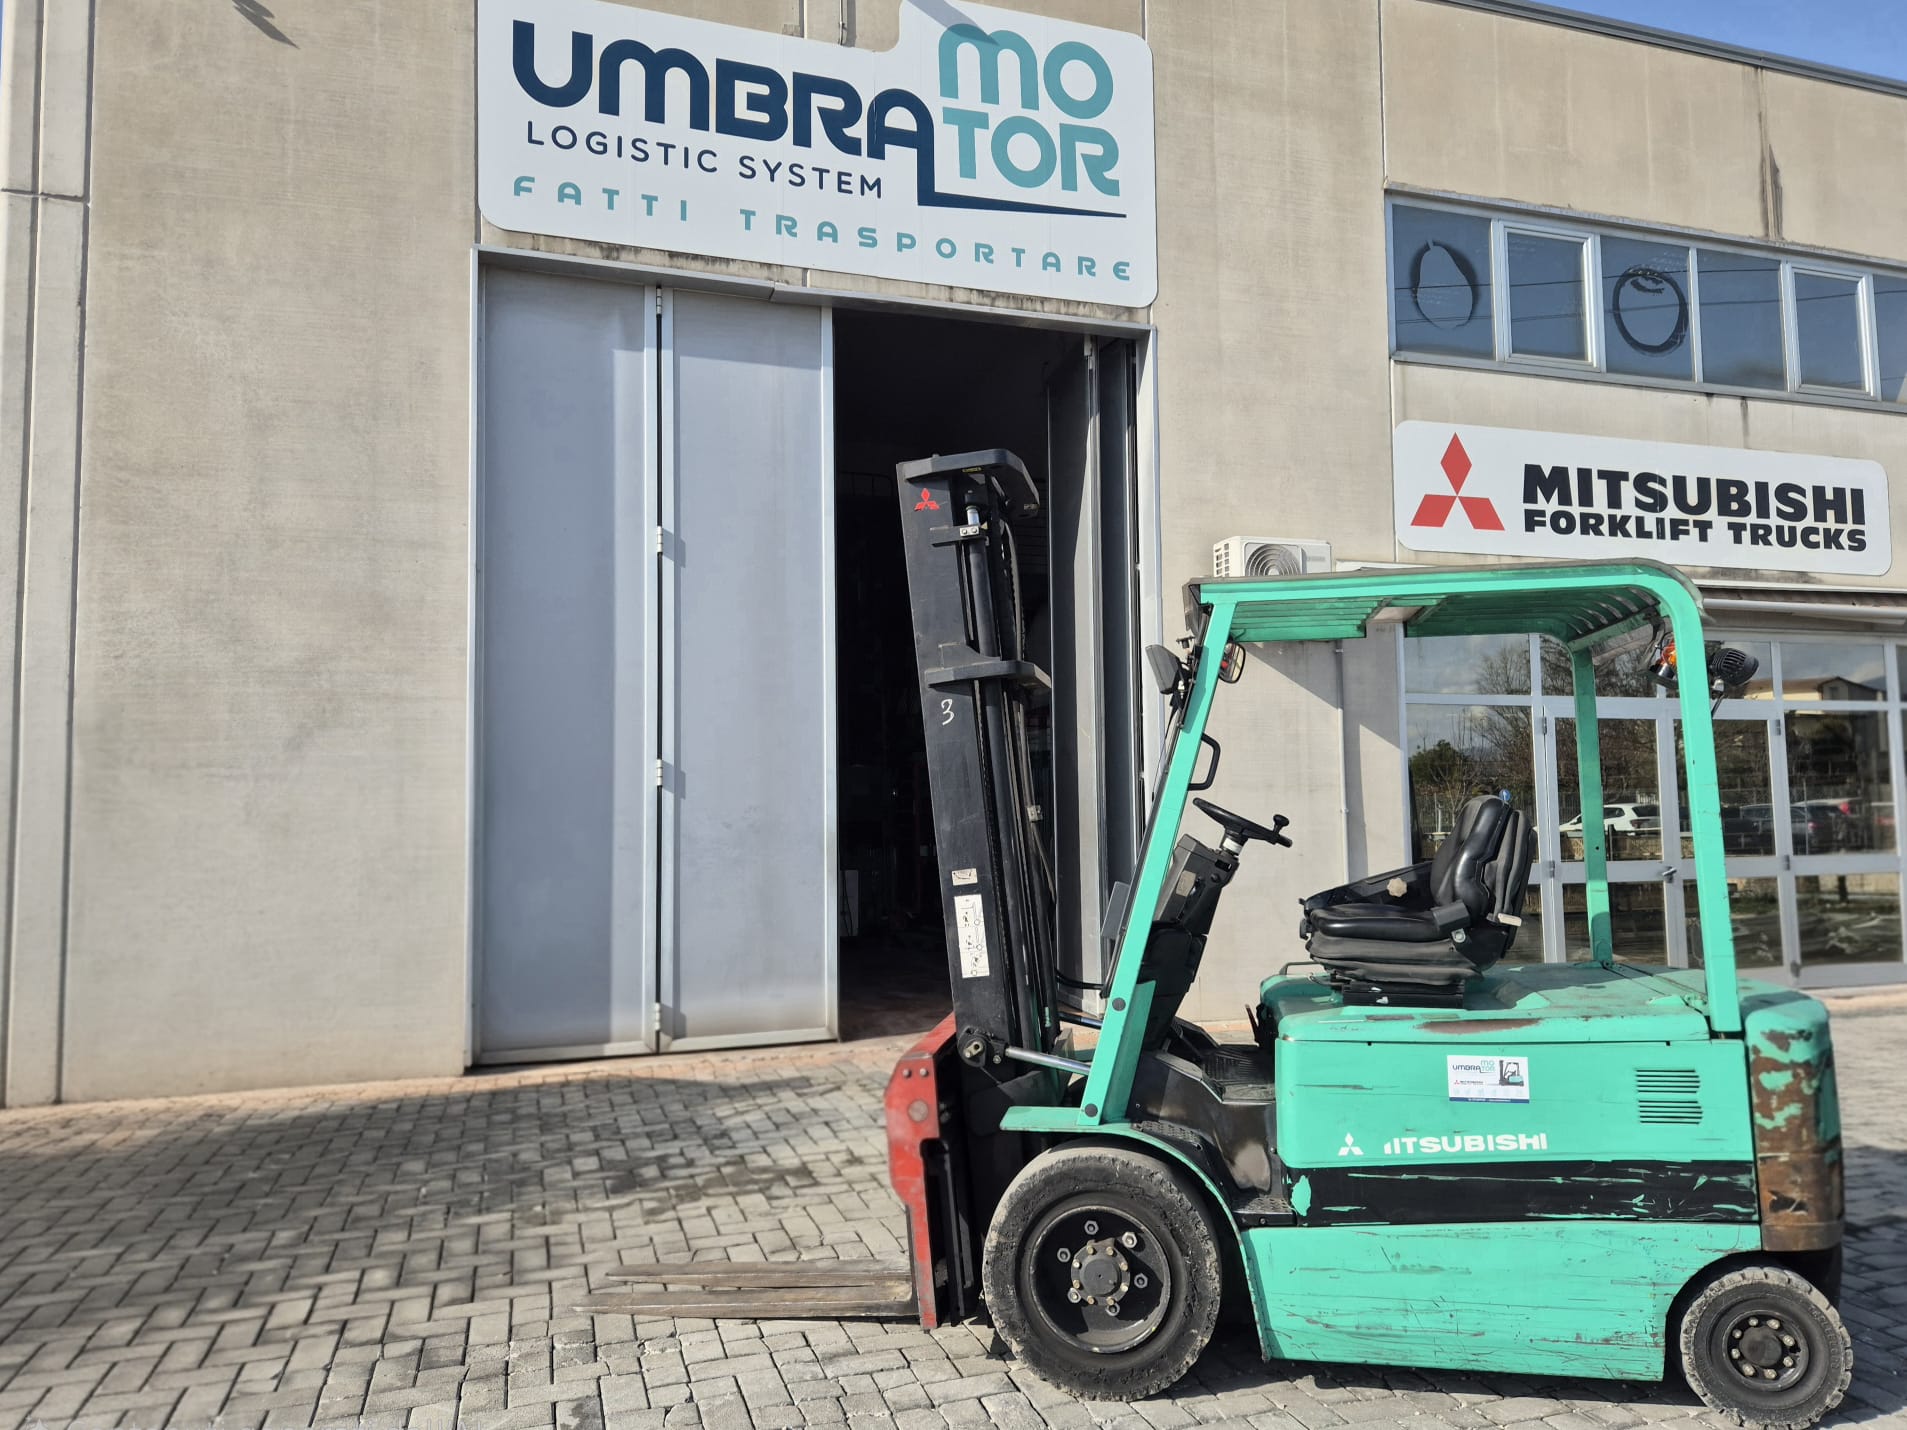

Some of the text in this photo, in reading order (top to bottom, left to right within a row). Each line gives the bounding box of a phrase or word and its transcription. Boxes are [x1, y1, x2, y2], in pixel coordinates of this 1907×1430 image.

[512, 20, 936, 162] UMBRA
[938, 23, 1114, 119] MO
[527, 120, 882, 200] LOGISTIC SYSTEM
[942, 109, 1120, 197] TOR
[513, 175, 1131, 282] FATTI TRASPORTARE
[1522, 463, 1866, 526] MITSUBISHI
[1524, 509, 1867, 552] FORKLIFT TRUCKS
[941, 698, 955, 726] 3
